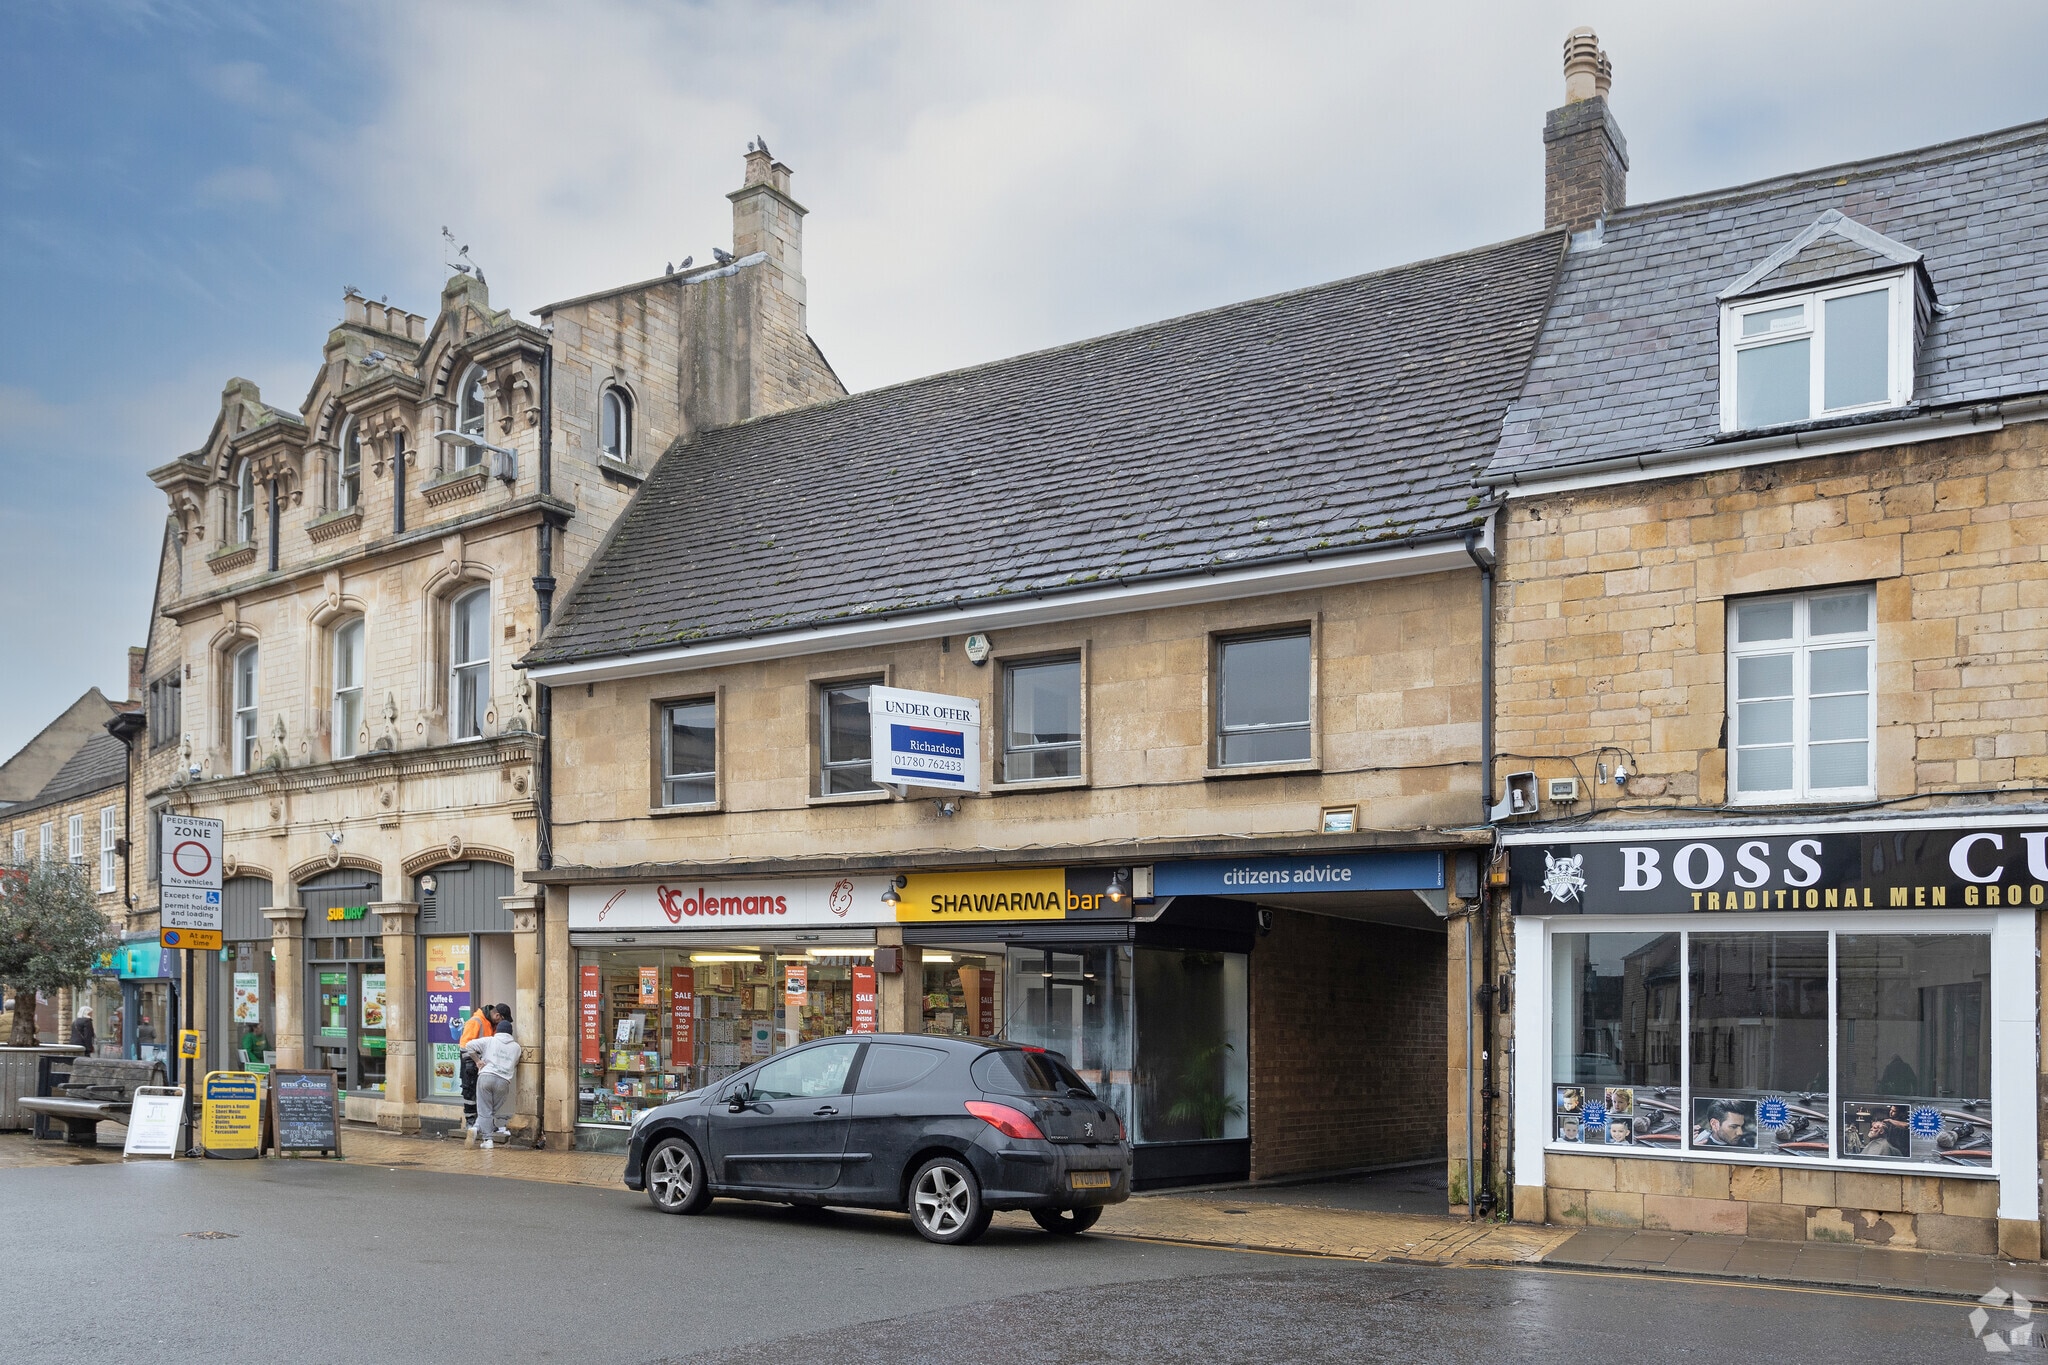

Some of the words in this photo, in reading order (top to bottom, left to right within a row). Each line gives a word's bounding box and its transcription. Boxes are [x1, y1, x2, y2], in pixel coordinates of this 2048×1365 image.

[885, 700, 930, 717] UNDER
[934, 706, 970, 722] OFFER
[910, 740, 961, 755] Richardson
[894, 755, 925, 768] 01780
[928, 758, 962, 772] 762433
[166, 816, 219, 828] PEDESTRIAN
[174, 826, 212, 838] ZONE
[1618, 840, 1822, 892] BOSS
[1223, 866, 1290, 885] citizens
[1293, 865, 1352, 883] advice
[184, 878, 214, 886] vehicles
[164, 892, 190, 900] Except
[931, 891, 1061, 913] SHAWARMA
[1067, 889, 1105, 910] bar
[1691, 887, 1874, 911] TRADITIONAL
[1890, 886, 1946, 907] MEN
[657, 885, 787, 924] Colemans
[187, 911, 214, 919] loading
[327, 906, 368, 921] SUBWAY
[171, 918, 188, 926] 4pm
[451, 944, 470, 954] £3.29
[430, 994, 448, 1004] Coffee
[448, 995, 453, 1004] &
[430, 1003, 448, 1012] Muffin
[430, 1014, 447, 1024] £2.69
